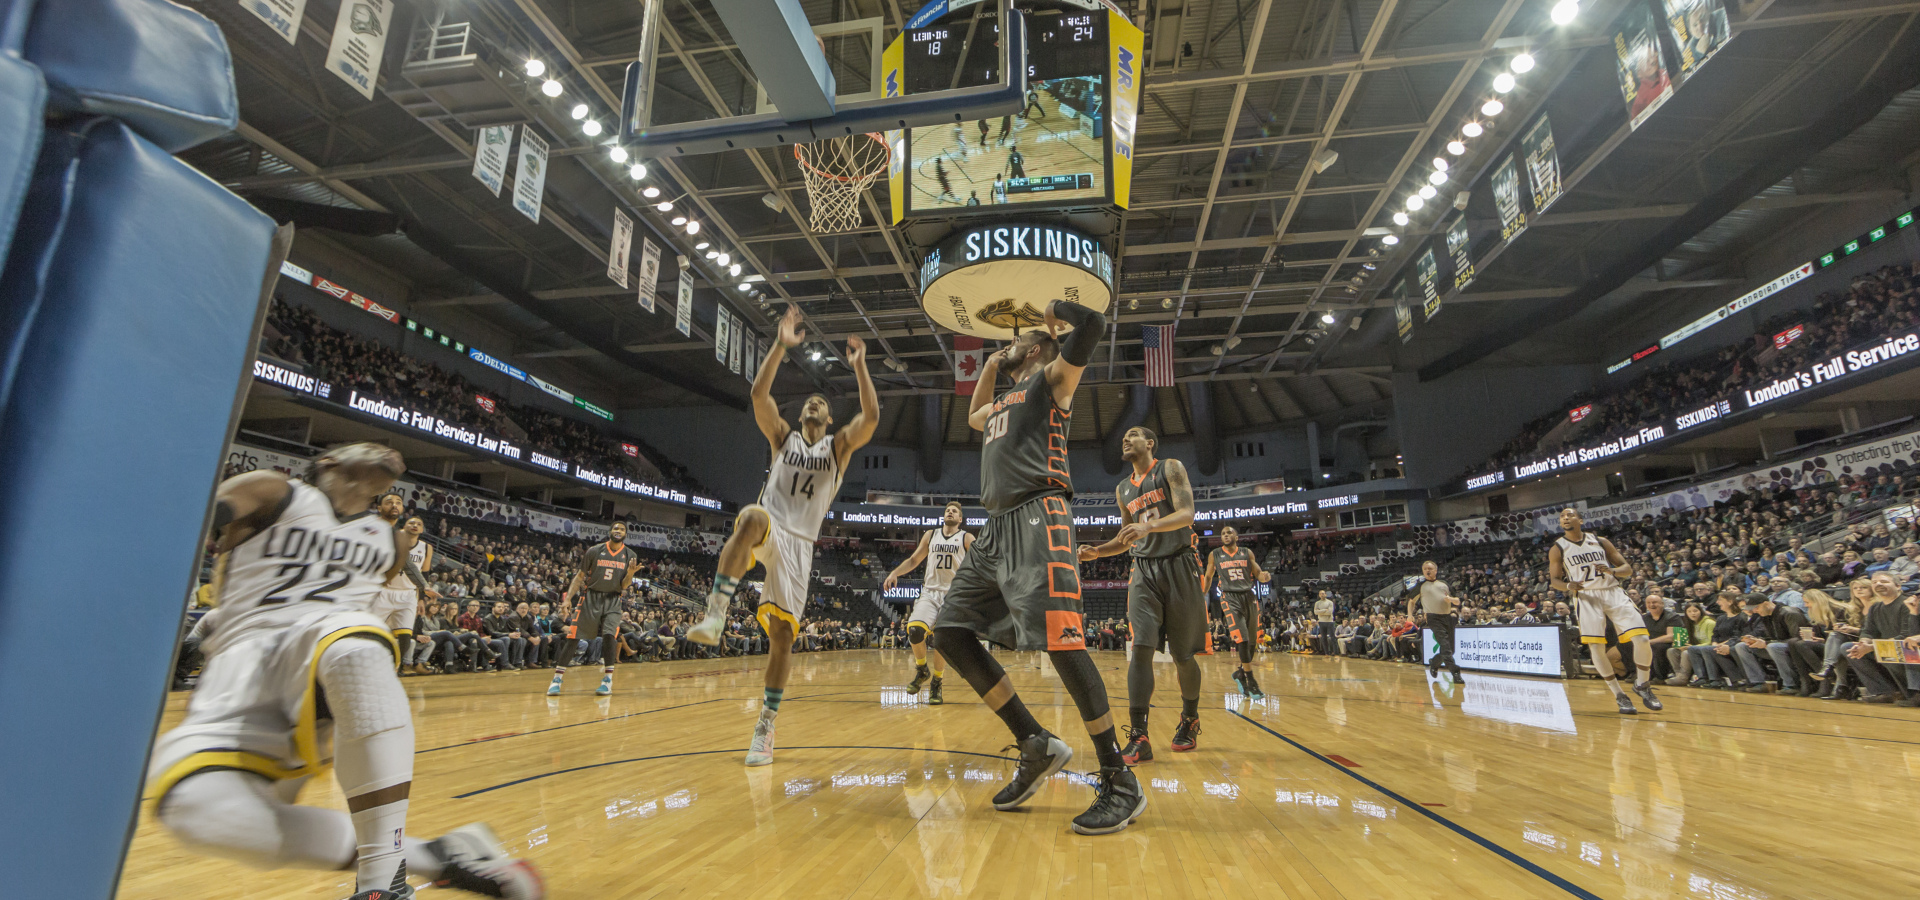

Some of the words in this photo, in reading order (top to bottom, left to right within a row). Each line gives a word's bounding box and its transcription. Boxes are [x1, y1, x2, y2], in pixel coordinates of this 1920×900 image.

[256, 2, 291, 37] OHL
[1074, 27, 1093, 41] 24
[928, 41, 941, 55] 18
[337, 60, 369, 90] OHL
[1117, 45, 1134, 93] MR.
[1115, 95, 1132, 160] LUBE
[524, 127, 547, 151] LONDON
[522, 136, 547, 161] KNIGHTS
[480, 169, 500, 192] OHL
[1898, 214, 1913, 225] TD
[1870, 229, 1884, 239] TD
[965, 227, 1094, 268] SISKINDS
[1845, 242, 1858, 252] TD
[927, 256, 941, 271] LAW
[1821, 254, 1833, 264] TD
[1738, 282, 1778, 308] CANADIAN
[1780, 271, 1800, 286] TIRE
[1632, 345, 1659, 361] HONDA
[484, 354, 509, 373] DELTA
[1745, 371, 1813, 407] London's
[1812, 355, 1845, 384] Full
[1846, 332, 1920, 371] Service
[253, 360, 315, 393] SISKINDS
[349, 390, 410, 425] London's
[411, 411, 434, 433] Full
[435, 420, 475, 445] Service
[477, 433, 498, 453] Law
[499, 439, 520, 459] Firm
[1676, 404, 1718, 430] SISKINDS
[985, 409, 1010, 446] 30
[531, 451, 560, 470] SISKINDS
[783, 450, 831, 471] LONDON
[1515, 457, 1557, 479] London's
[1557, 450, 1578, 468] Full
[1579, 442, 1619, 461] Service
[1619, 433, 1640, 451] Law
[1640, 426, 1665, 444] Firm
[1835, 445, 1891, 466] Protecting
[1891, 440, 1912, 453] the
[576, 465, 607, 487] London's
[608, 475, 624, 489] Full
[624, 479, 653, 496] Service
[654, 486, 670, 499] Law
[670, 490, 686, 503] Firm
[790, 471, 814, 500] 14
[1467, 473, 1496, 490] SISKINDS
[692, 495, 715, 509] SISKINDS
[1126, 487, 1166, 516] MONCTON
[1318, 495, 1348, 508] SISKINDS
[1611, 506, 1621, 515] for
[1622, 501, 1644, 514] Better
[843, 511, 877, 523] London's
[878, 513, 892, 524] Full
[893, 514, 920, 525] Service
[922, 516, 938, 526] Law
[1219, 509, 1233, 520] Full
[1235, 505, 1265, 519] Service
[1266, 504, 1285, 516] Law
[1287, 502, 1307, 513] Firm
[538, 520, 548, 528] 3M
[1073, 516, 1089, 526] vice
[1090, 516, 1106, 525] Law
[1467, 526, 1479, 534] 3M
[263, 525, 388, 577] LONDON
[932, 544, 960, 554] LONDON
[936, 554, 953, 569] 20
[1219, 560, 1247, 570] MONCTON
[1567, 551, 1605, 566] LONDON
[603, 568, 614, 580] 5
[1228, 568, 1245, 581] 55
[1581, 565, 1605, 582] 24
[259, 563, 351, 606] 22
[883, 587, 920, 598] SISKINDS
[1460, 640, 1472, 650] Boys
[1472, 640, 1477, 649] &
[1478, 640, 1491, 650] Girls
[1492, 640, 1509, 650] Clubs
[1510, 641, 1517, 650] of
[1518, 641, 1543, 651] Canada
[1460, 652, 1472, 661] Clubs
[1472, 653, 1492, 663] Garçons
[1492, 654, 1498, 662] et
[1498, 654, 1512, 663] Filles
[1512, 655, 1521, 664] du
[1521, 655, 1544, 665] Canada
